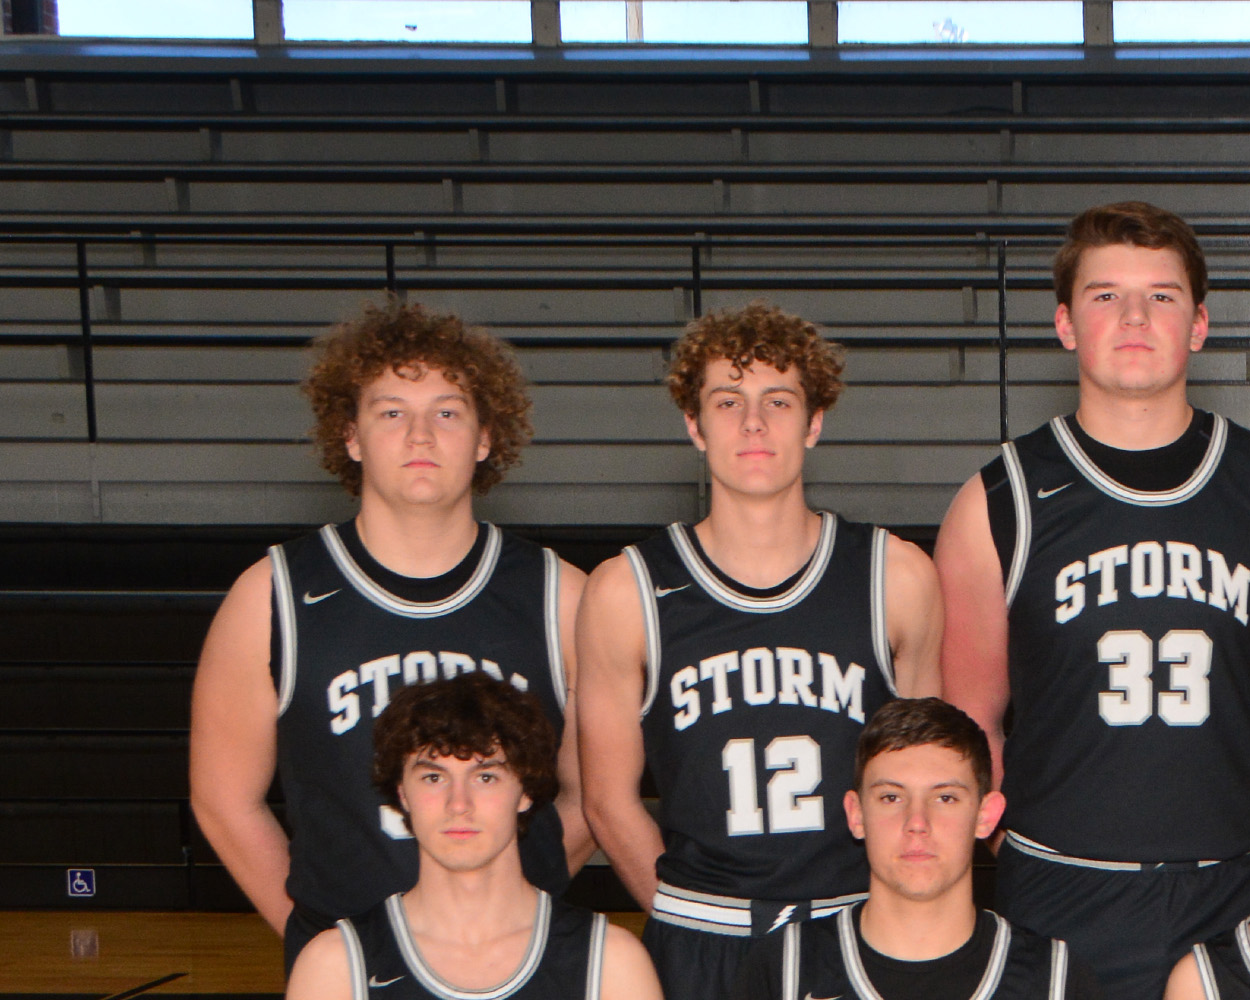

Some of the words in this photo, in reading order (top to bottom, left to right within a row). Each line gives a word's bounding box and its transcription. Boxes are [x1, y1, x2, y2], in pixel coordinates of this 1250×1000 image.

[327, 650, 529, 735] STO
[670, 647, 866, 731] STORM
[1096, 630, 1214, 726] 33
[721, 736, 825, 837] 12
